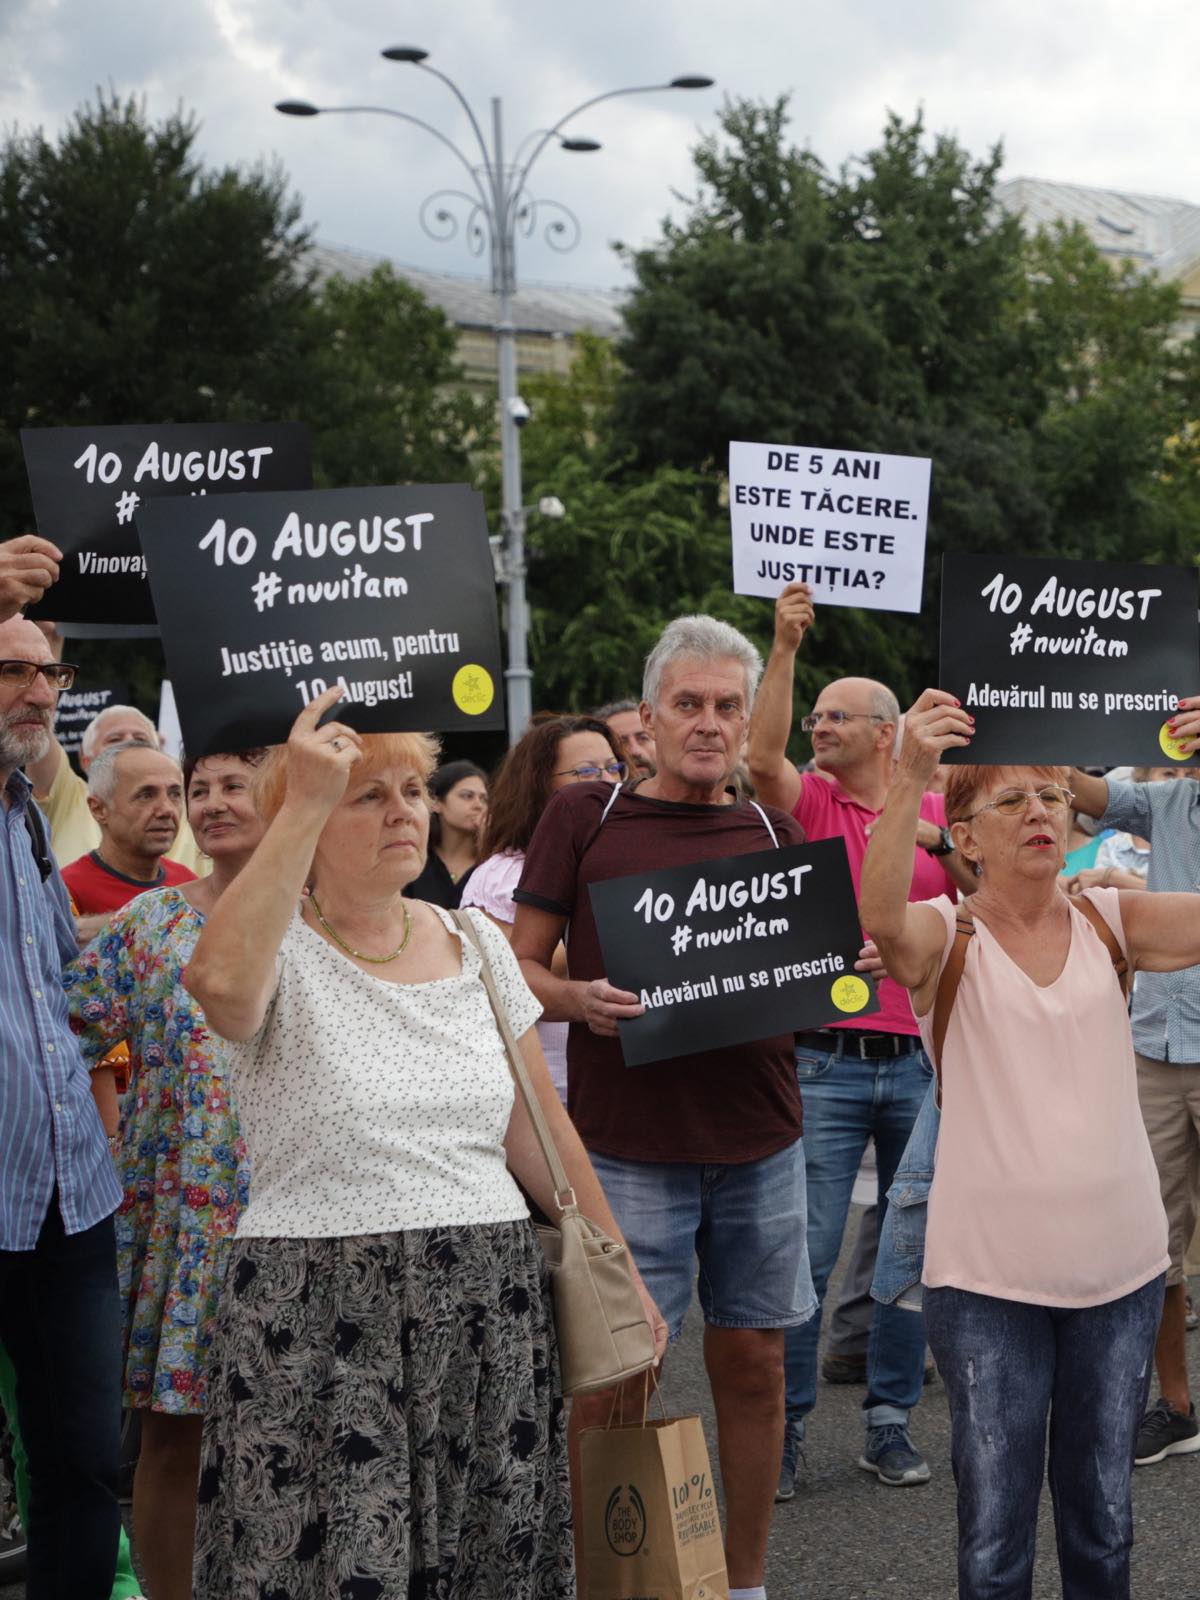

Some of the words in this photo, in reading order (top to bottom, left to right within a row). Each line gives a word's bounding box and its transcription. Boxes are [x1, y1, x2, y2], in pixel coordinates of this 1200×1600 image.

[73, 443, 123, 484] 10
[133, 441, 274, 483] AUGUST
[767, 451, 800, 473] DE
[808, 454, 823, 475] 5
[831, 457, 881, 480] ANI
[735, 484, 792, 509] ESTE
[800, 488, 918, 521] TĂCERE.
[198, 518, 257, 566] 10
[271, 511, 435, 561] AUGUST
[750, 522, 815, 547] UNDE
[824, 529, 895, 555] ESTE
[981, 572, 1023, 614] 10
[1030, 575, 1162, 621] AUGUST
[221, 639, 314, 677] Justiție
[319, 637, 389, 663] acum,
[392, 628, 460, 661] pentru
[965, 682, 1045, 709] Adevărul
[1051, 691, 1073, 709] nu
[1078, 692, 1099, 710] se
[1103, 689, 1179, 715] prescrie
[633, 887, 675, 924] 10
[684, 864, 813, 919] AUGUST
[639, 974, 719, 1011] Adevărul
[722, 975, 746, 994] nu
[749, 970, 770, 988] se
[773, 952, 845, 987] prescrie
[612, 1518, 638, 1530] BODY
[617, 1506, 631, 1518] THE
[613, 1531, 637, 1544] SHOP
